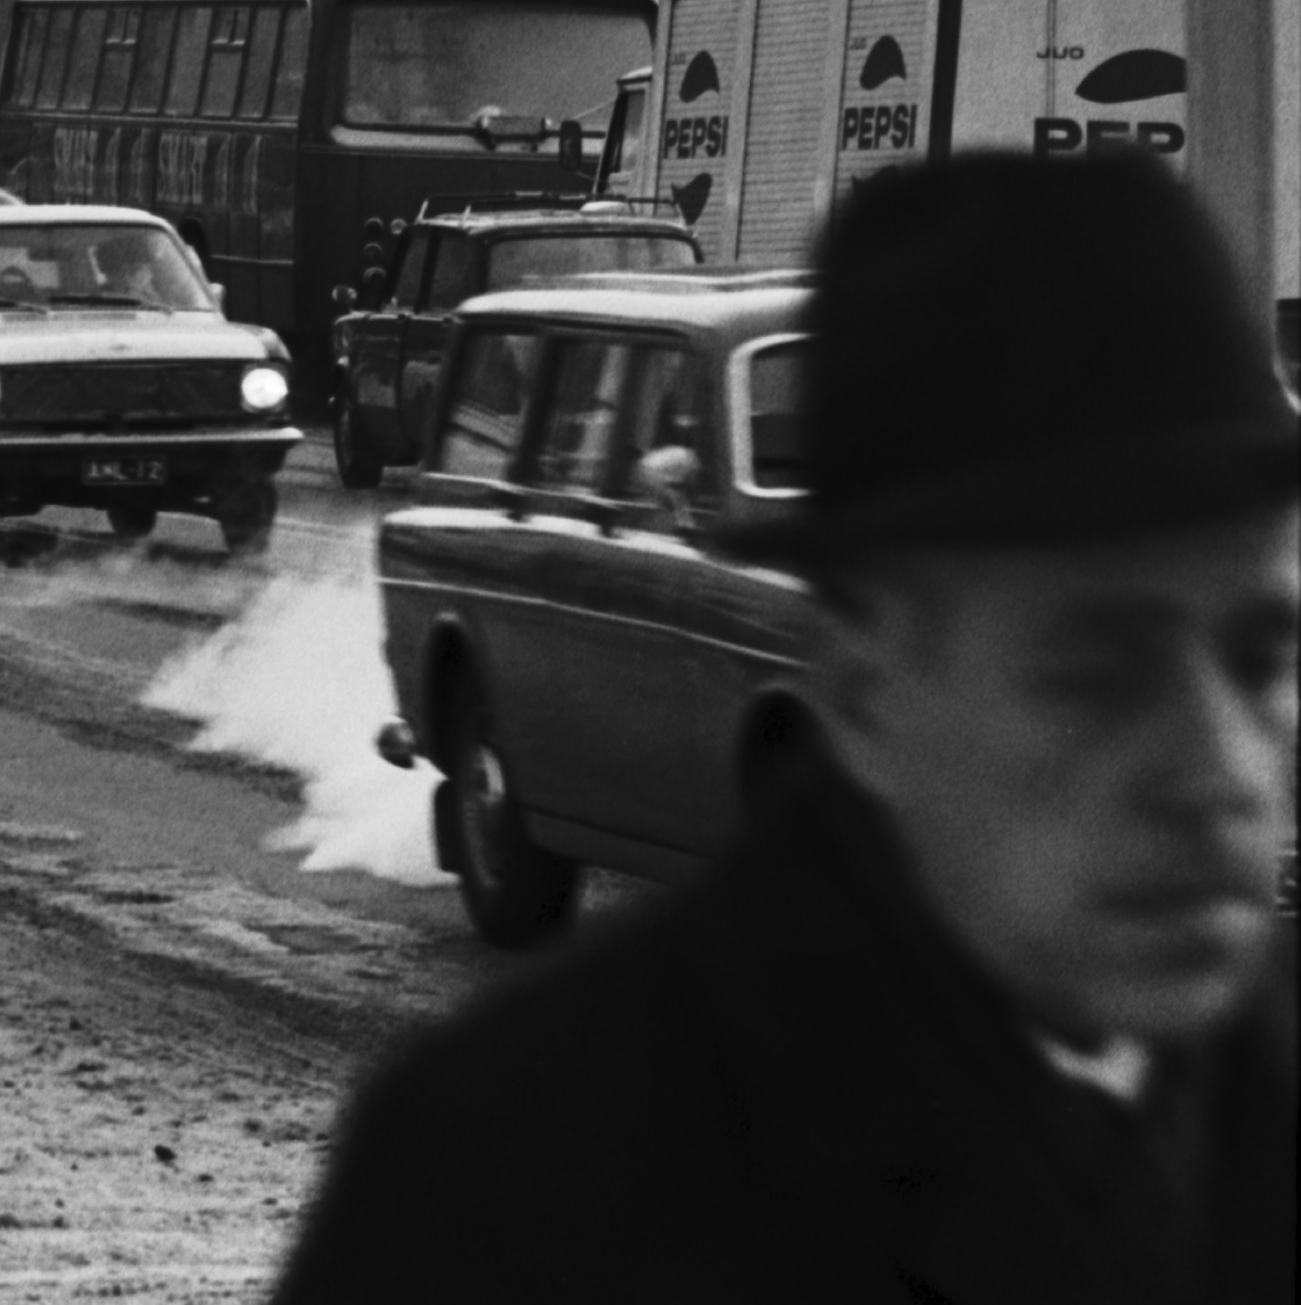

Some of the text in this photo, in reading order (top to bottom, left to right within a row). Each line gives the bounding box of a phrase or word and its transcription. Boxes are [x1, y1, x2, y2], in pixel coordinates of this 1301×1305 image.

[1036, 45, 1086, 61] JUO
[664, 116, 729, 159] PEPSI
[842, 103, 918, 151] PEPSI
